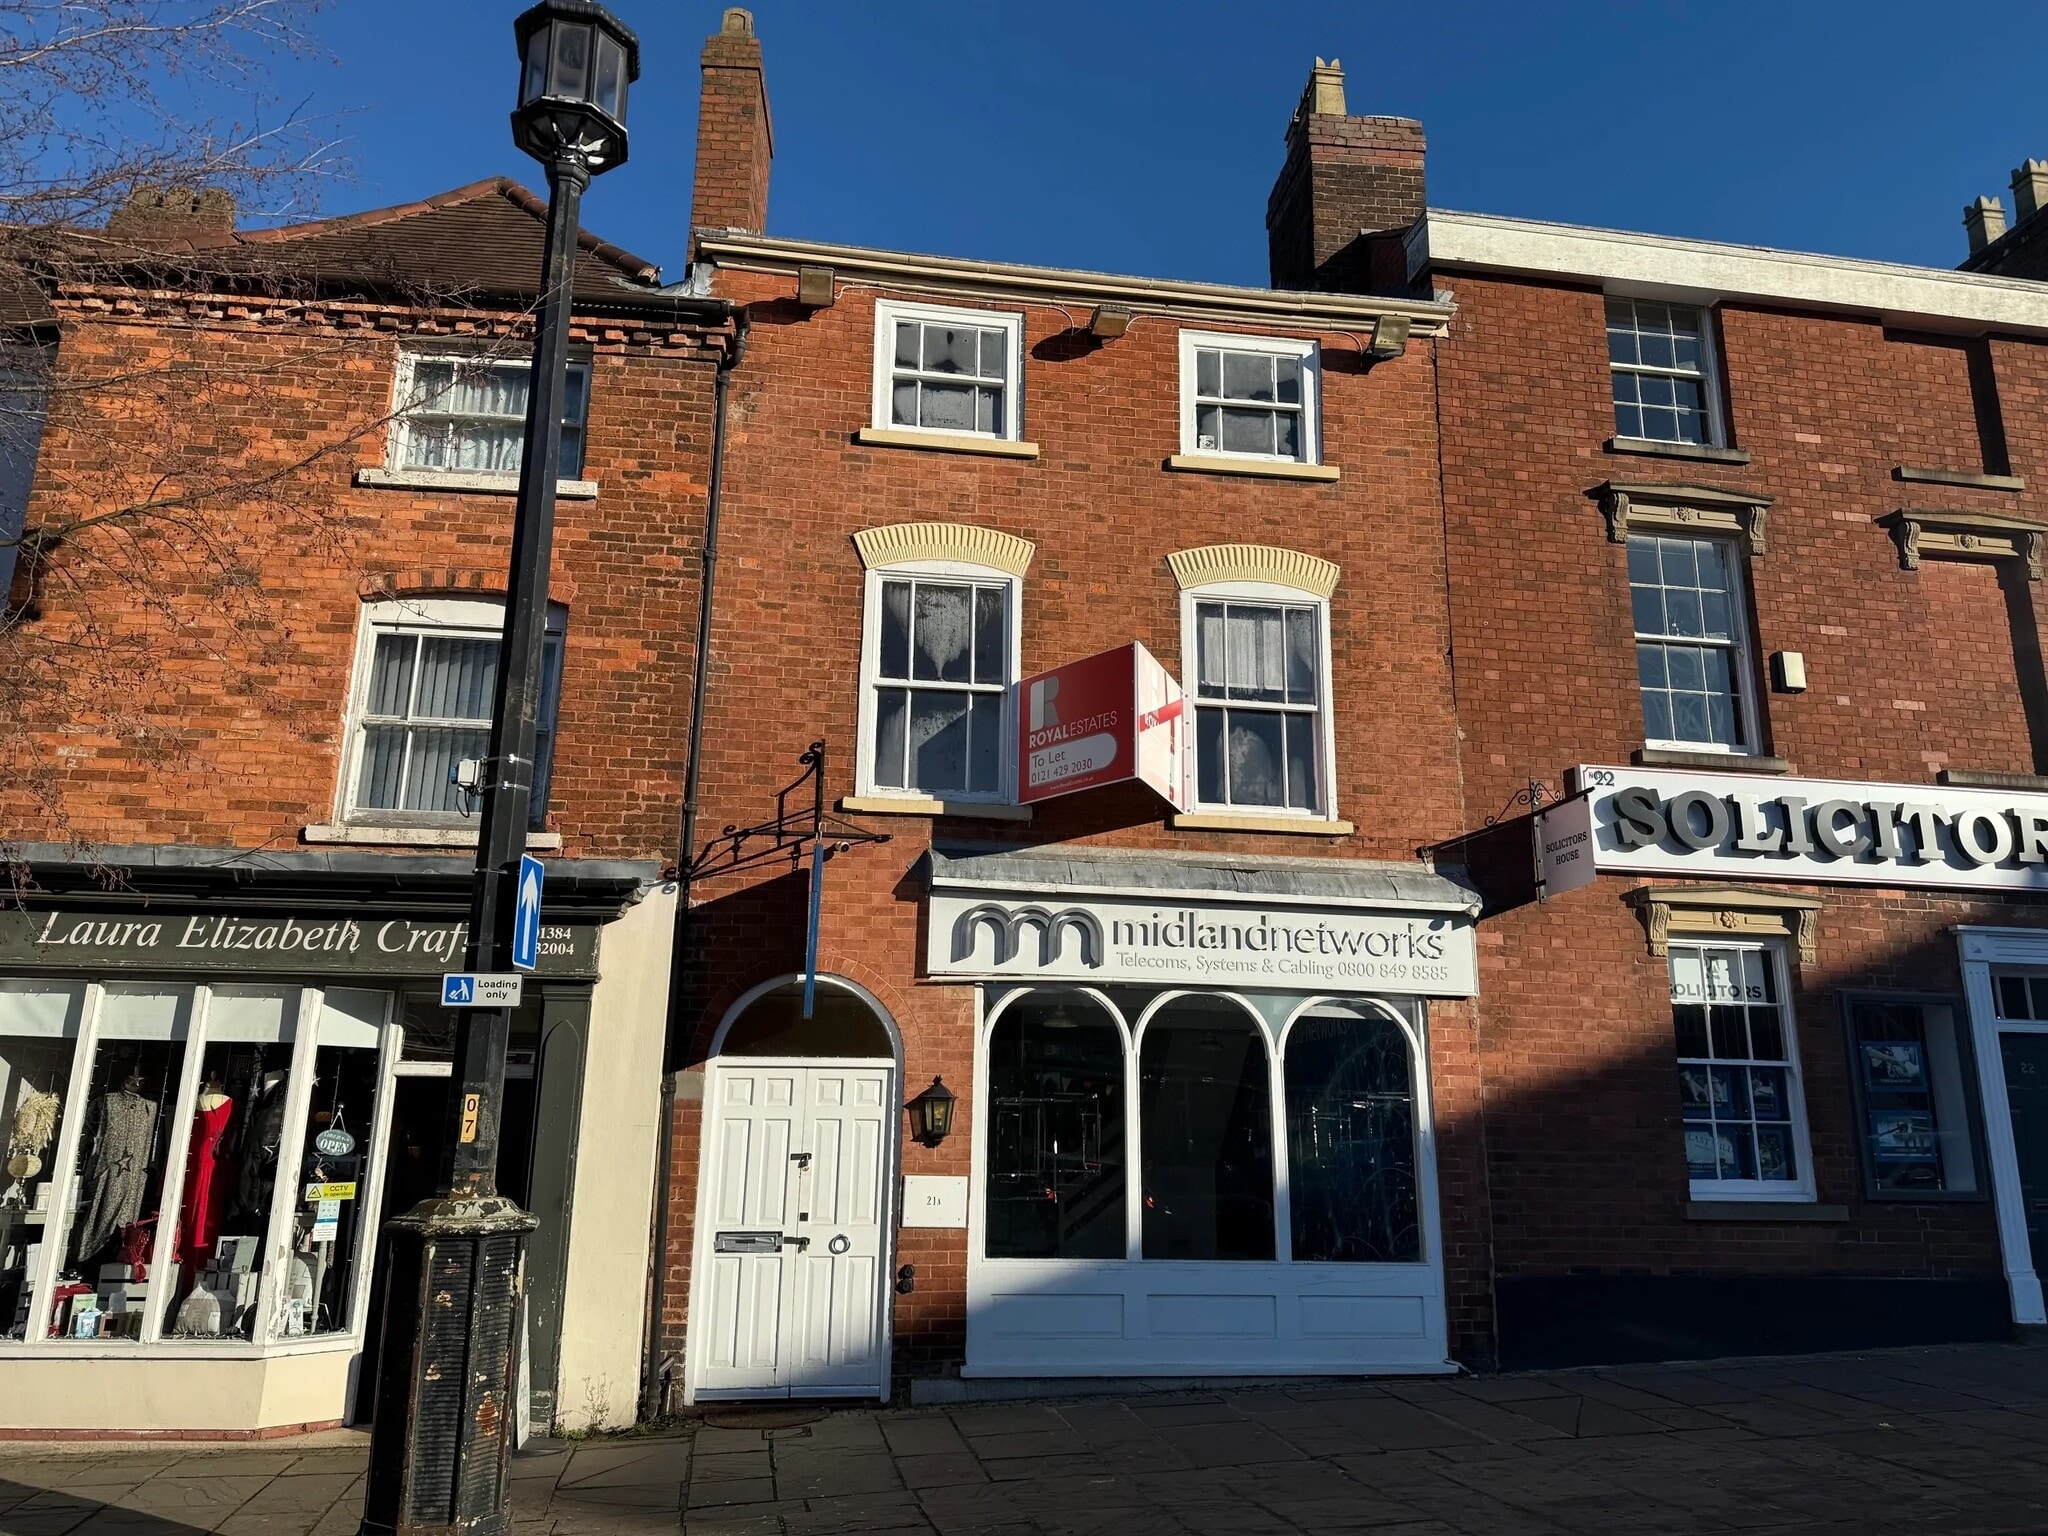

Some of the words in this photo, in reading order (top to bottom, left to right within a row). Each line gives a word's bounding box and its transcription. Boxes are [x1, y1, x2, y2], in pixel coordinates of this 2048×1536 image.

[1029, 725, 1069, 748] ROYAL
[1070, 710, 1117, 736] ESTATES
[1032, 755, 1045, 768] To
[1048, 751, 1066, 764] Let
[1031, 770, 1050, 783] 0121
[1053, 765, 1069, 777] 429
[1071, 759, 1093, 773] 2030
[1545, 831, 1588, 853] SOLICITORS
[1555, 849, 1580, 865] HOUSE
[36, 911, 162, 947] Laura
[176, 914, 361, 952] Elizabeth
[536, 926, 571, 940] 1384
[1112, 911, 1446, 960] midlandnetworks
[1116, 951, 1191, 971] Telecoms,
[1196, 953, 1257, 974] Systems
[1261, 958, 1275, 973] &
[1278, 957, 1334, 979] Cabling
[1338, 961, 1375, 977] 0800
[1380, 963, 1407, 979] 849
[1412, 965, 1448, 981] 8585
[478, 979, 518, 991] Loading
[485, 990, 508, 1000] only
[2020, 1062, 2035, 1074] 22
[320, 1138, 350, 1153] OPEN
